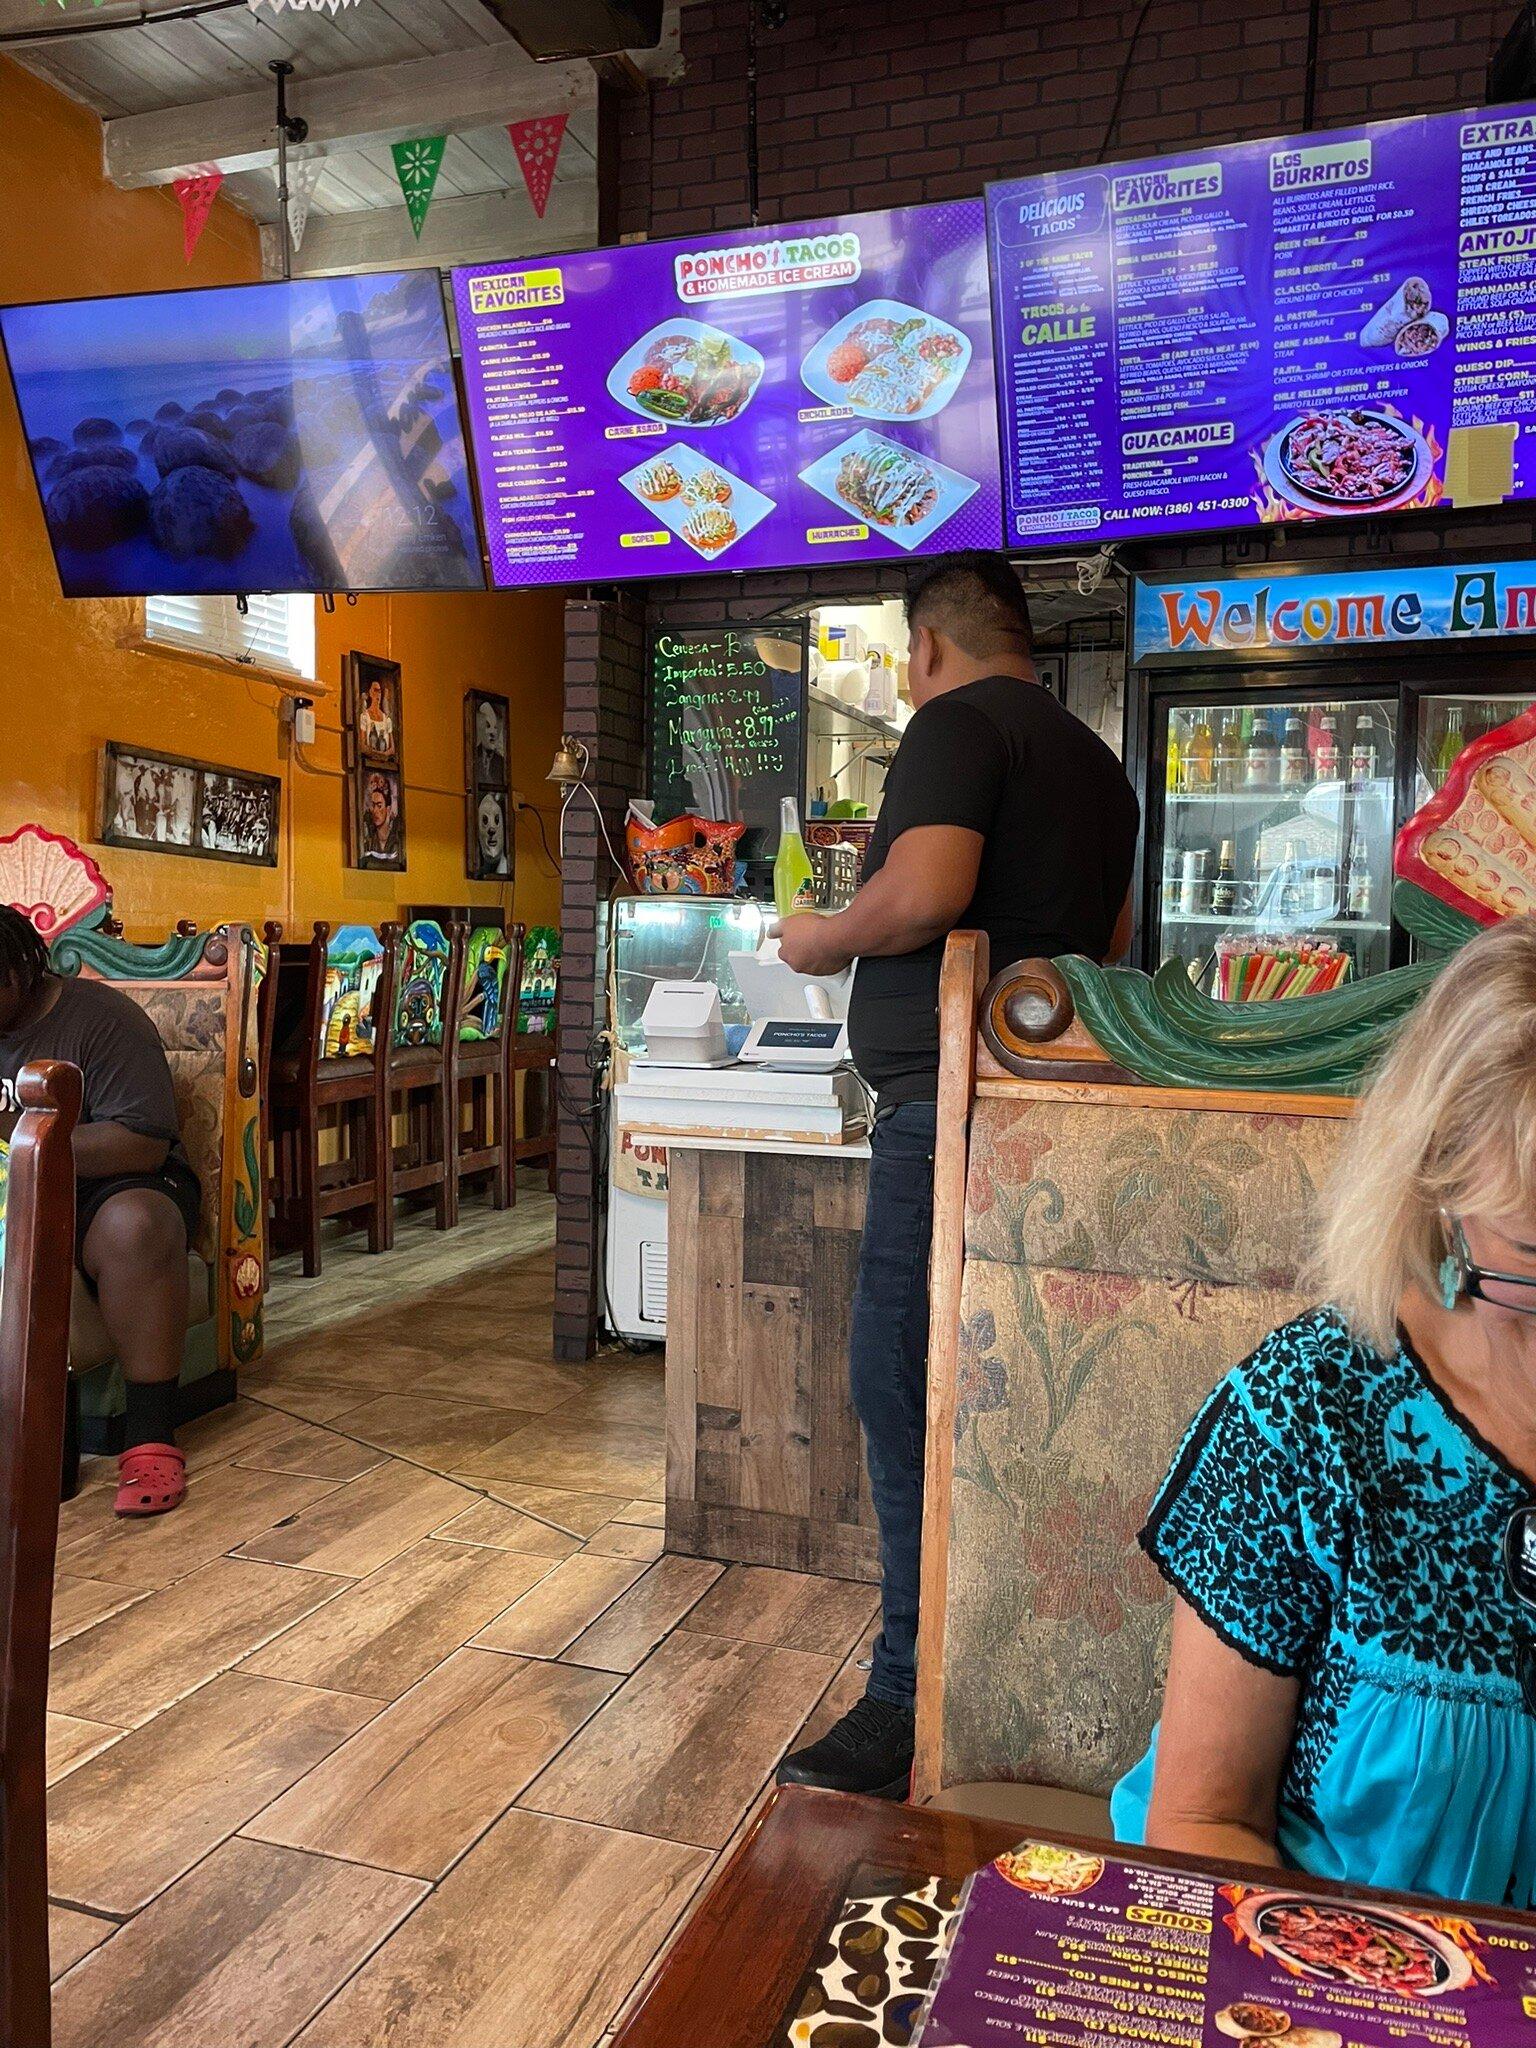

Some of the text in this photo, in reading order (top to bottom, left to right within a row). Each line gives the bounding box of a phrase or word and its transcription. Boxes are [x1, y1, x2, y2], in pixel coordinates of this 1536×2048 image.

[1462, 120, 1536, 146] EXTRA
[1272, 153, 1301, 170] LOS
[1462, 144, 1534, 162] RICE AND BEANS
[1272, 158, 1369, 188] BURRITOS
[1461, 156, 1530, 173] GUACAMOLE DIP
[1116, 174, 1168, 193] MEXICAN
[1461, 167, 1526, 184] CHIPS & SALSA
[1116, 176, 1218, 207] FAVORITES
[1272, 184, 1378, 206] ALL BURRITOS FILLED WITH
[1460, 179, 1517, 195] SOUR CREAM
[1460, 190, 1522, 206] FRENCH FRIES
[1019, 192, 1085, 224] DELICIOUS
[1298, 203, 1317, 213] SOUR
[1460, 203, 1504, 217] SHREDDED
[1272, 210, 1340, 226] GUACAMOLE PICO
[1316, 212, 1392, 230] BURRITO BOWL FOR
[1460, 216, 1490, 228] CHILES
[1032, 218, 1076, 238] TACOS
[1460, 228, 1536, 252] ANTOJI
[786, 238, 855, 264] TACOS
[1303, 262, 1338, 274] BURRITO
[1458, 252, 1530, 270] STEAK FRIES
[472, 276, 525, 293] MEXICAN
[686, 262, 853, 295] & HOMEMADE ICE CREAM
[474, 285, 560, 310] FAVORITES
[1274, 282, 1320, 296] CLASICO
[1274, 287, 1364, 306] GROUND OR CHICKEN
[1458, 281, 1527, 298] EMPANADAS
[1021, 302, 1064, 320] TACOS
[1274, 310, 1318, 323] AL PASTOR
[1456, 311, 1506, 325] FLAUTAS
[1508, 310, 1524, 321] (5)
[1022, 316, 1096, 346] CALLE
[1299, 318, 1335, 328] PINEAPPLE
[1274, 335, 1330, 350] CARNE ASADA
[1455, 340, 1494, 352] WINGS
[1495, 338, 1504, 348] &
[1274, 350, 1294, 358] STEAK
[1365, 359, 1429, 374] PEPPERS ONIONS
[1454, 358, 1514, 374] QUESO DIP
[1454, 374, 1496, 387] STREET
[1496, 370, 1530, 382] CORN
[1274, 383, 1369, 402] CHILE RELLENO BURRITO
[1274, 388, 1409, 411] BURRITO FILLED POBLANO PEPPER
[1452, 394, 1499, 406] NACHOS
[798, 406, 854, 420] ENCHILADAS
[608, 424, 664, 438] CARNE ASADA
[1124, 424, 1232, 451] GUACAMOLE
[1122, 460, 1164, 470] TRADITIONAL
[1123, 473, 1221, 490] FRESH GUACAMOLE WITH BACON
[1123, 490, 1145, 498] QUESO
[1066, 510, 1098, 520] TACOS
[1103, 496, 1250, 521] CALL NOW: (386) 451-0300
[631, 534, 655, 544] SOPES
[1158, 586, 1423, 649] Welcome
[726, 662, 766, 678] 5.50
[743, 716, 774, 738] 8.99
[1178, 1878, 1215, 1890] CHICKEN
[1192, 1888, 1214, 1897] BEEF
[1030, 1892, 1120, 1915] SAT & SUN ONLY
[1178, 1899, 1214, 1910] MENUDO
[1181, 1894, 1213, 1903] SHRIMP
[1130, 1908, 1209, 1932] SOUPS
[1179, 1906, 1212, 1918] POZOLE
[1106, 1934, 1210, 1958] NACHOS $11
[995, 1952, 1018, 1966] $12
[1111, 1951, 1208, 1974] STREET CORN
[986, 1968, 1020, 1982] CHEESE
[1068, 1969, 1096, 1981] (10)
[1100, 1975, 1140, 1990] FRIES
[1130, 1964, 1208, 1985] QUESO DIP
[974, 1990, 1010, 2004] FRESCO
[1035, 1984, 1056, 1997] $11
[1156, 1984, 1206, 2001] WINGS
[1244, 1992, 1332, 2015] PEPPERS ONIONS
[1326, 1993, 1374, 2010] BURRITO
[1035, 2009, 1056, 2022] $11
[1137, 2004, 1204, 2025] FLAUTAS
[1378, 2002, 1430, 2019] RELLENO
[1434, 2012, 1468, 2026] CHILE
[986, 2017, 1012, 2030] SOUR
[1108, 2022, 1202, 2048] EMPANADAS
